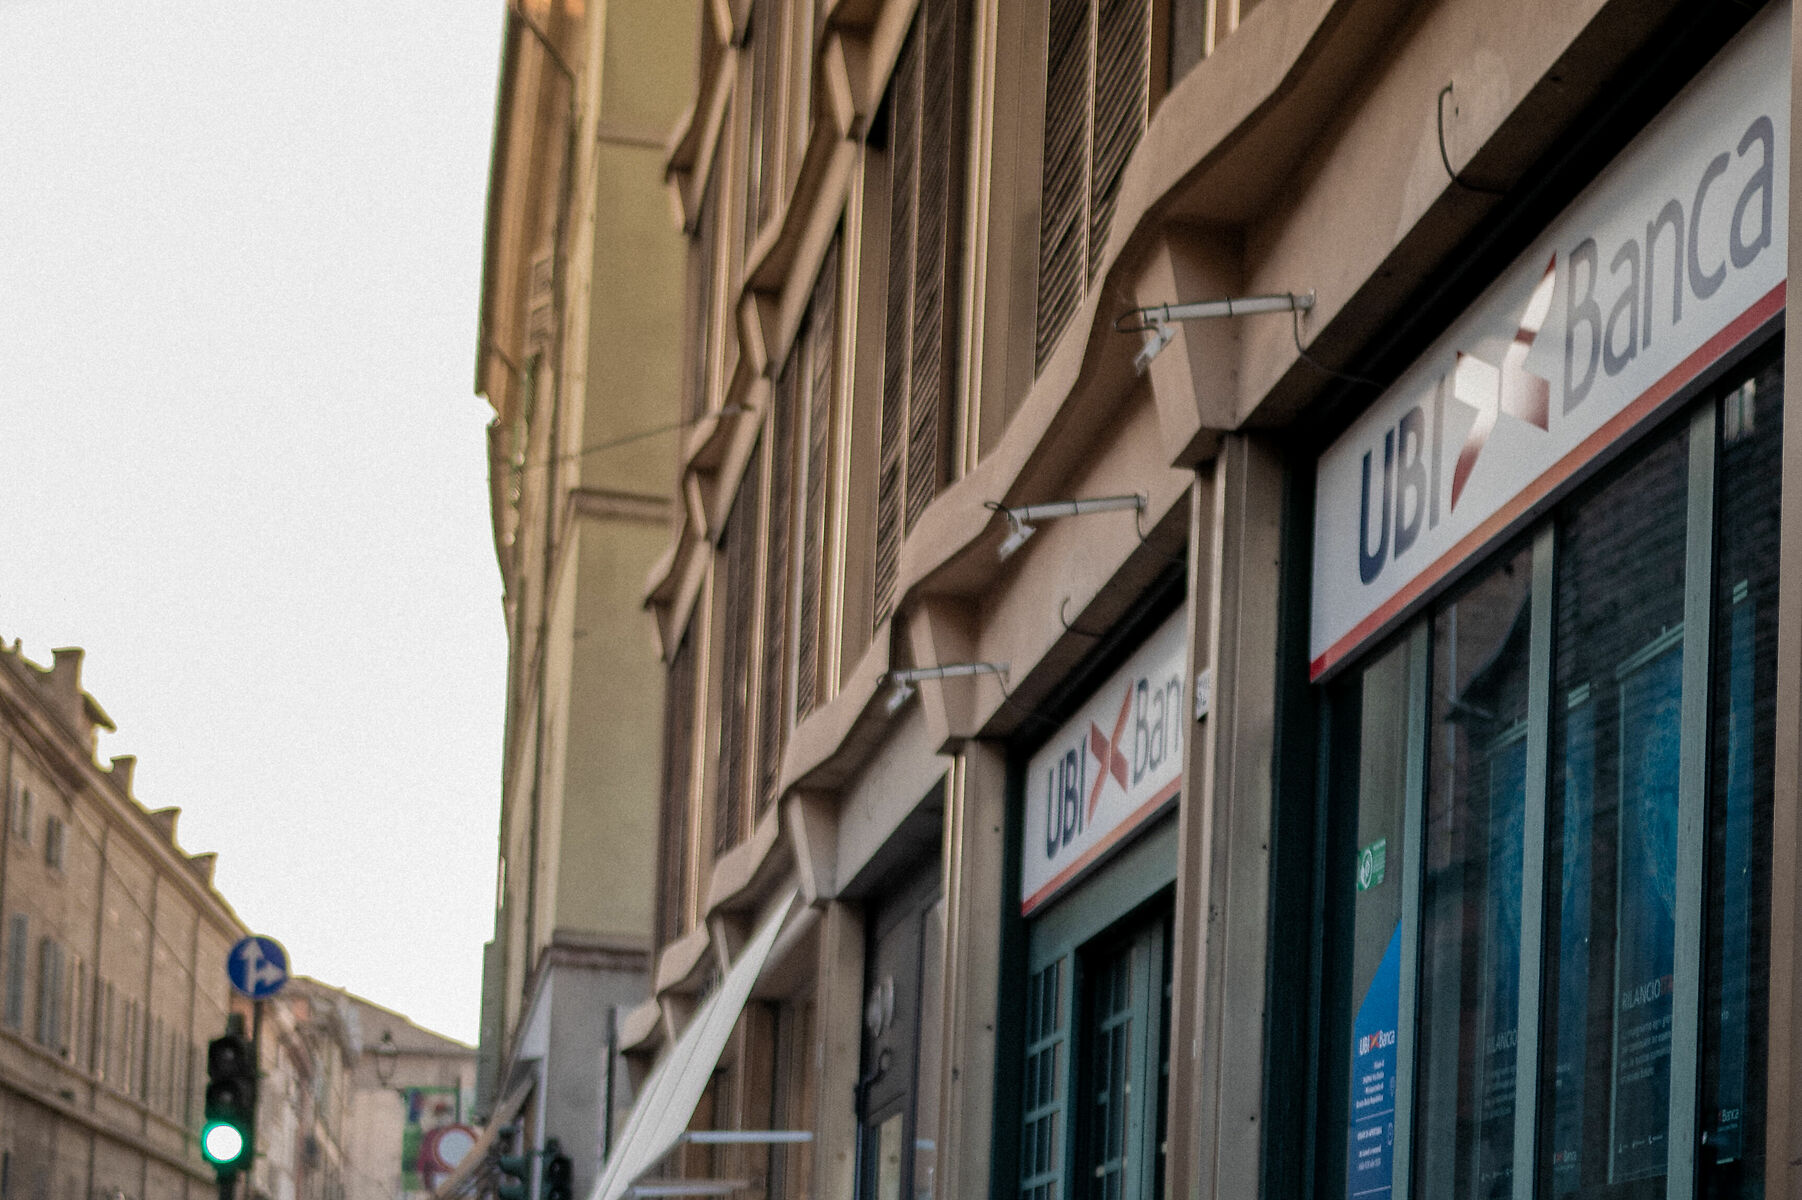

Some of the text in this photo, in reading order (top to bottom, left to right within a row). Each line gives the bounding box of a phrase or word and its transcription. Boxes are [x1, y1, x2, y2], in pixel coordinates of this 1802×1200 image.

[1358, 114, 1775, 586] UBI Banca
[1046, 673, 1184, 861] UBI Ban
[1359, 1029, 1395, 1056] UBI Banca
